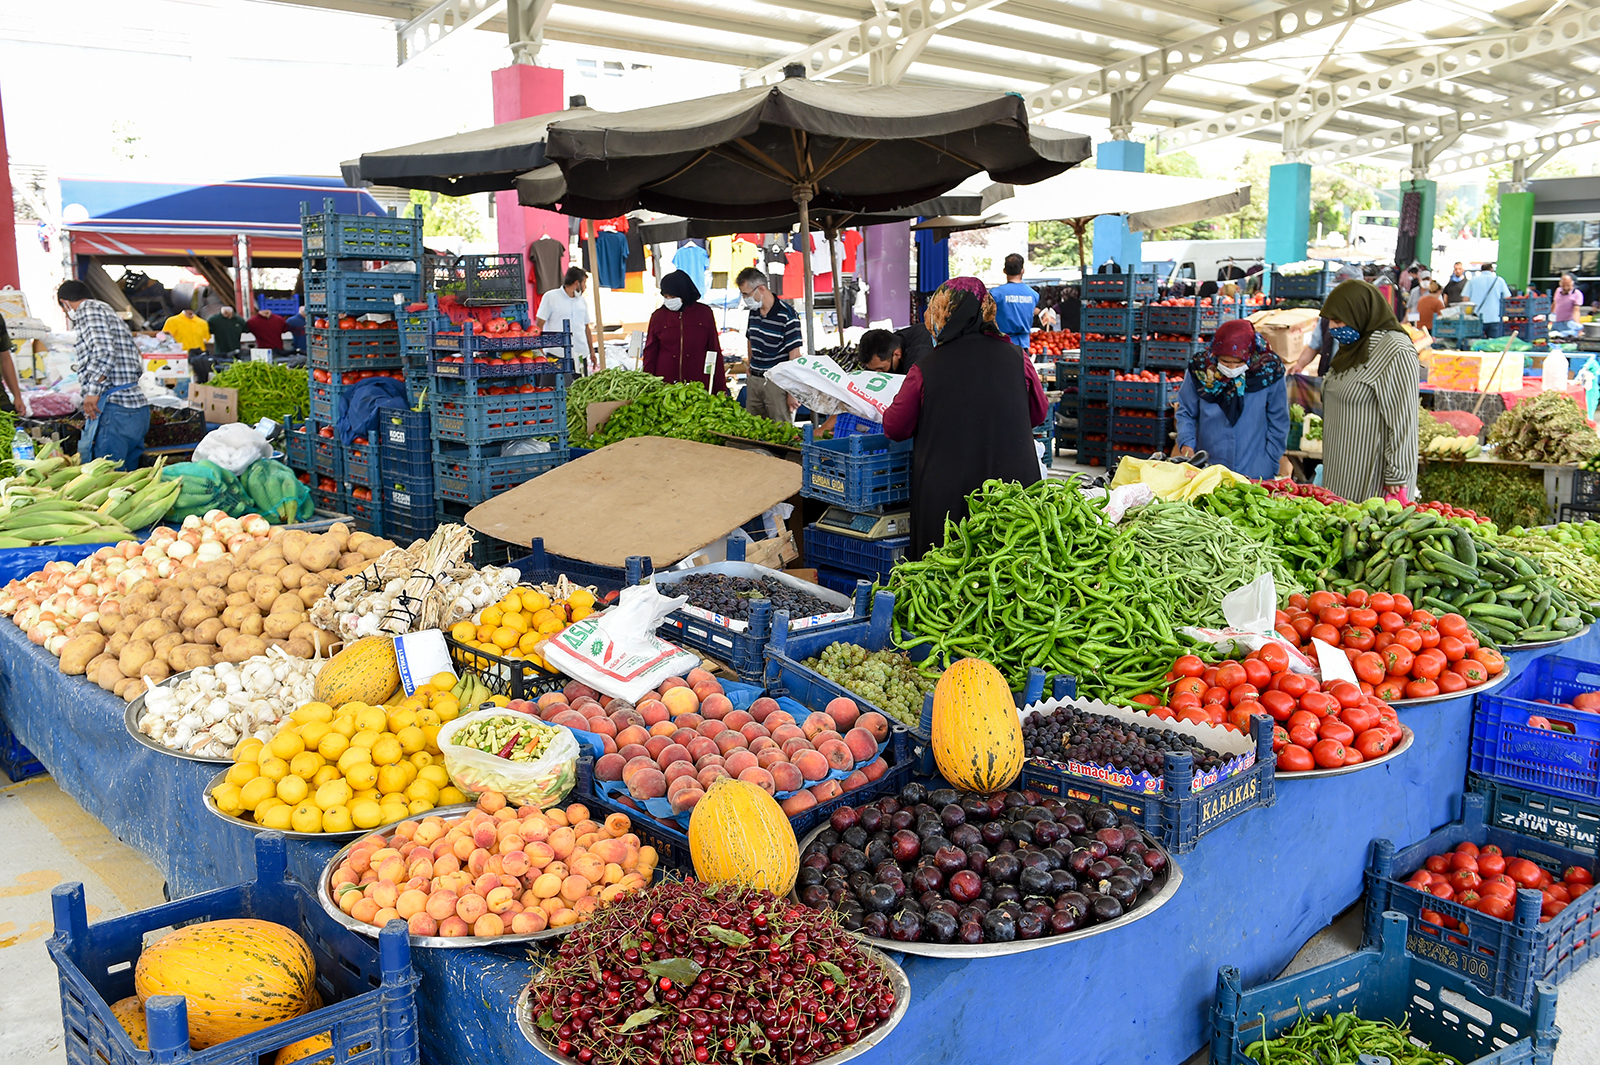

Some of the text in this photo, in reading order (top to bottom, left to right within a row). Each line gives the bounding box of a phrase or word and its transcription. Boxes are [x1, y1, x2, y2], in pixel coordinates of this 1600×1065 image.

[1113, 773, 1133, 786] 126
[1203, 773, 1217, 786] 126
[1202, 778, 1257, 822] KARAKAŞ
[1500, 812, 1548, 833] MUZ
[1518, 811, 1578, 830] ANAMUR
[1408, 934, 1489, 979] USTAFA 100
